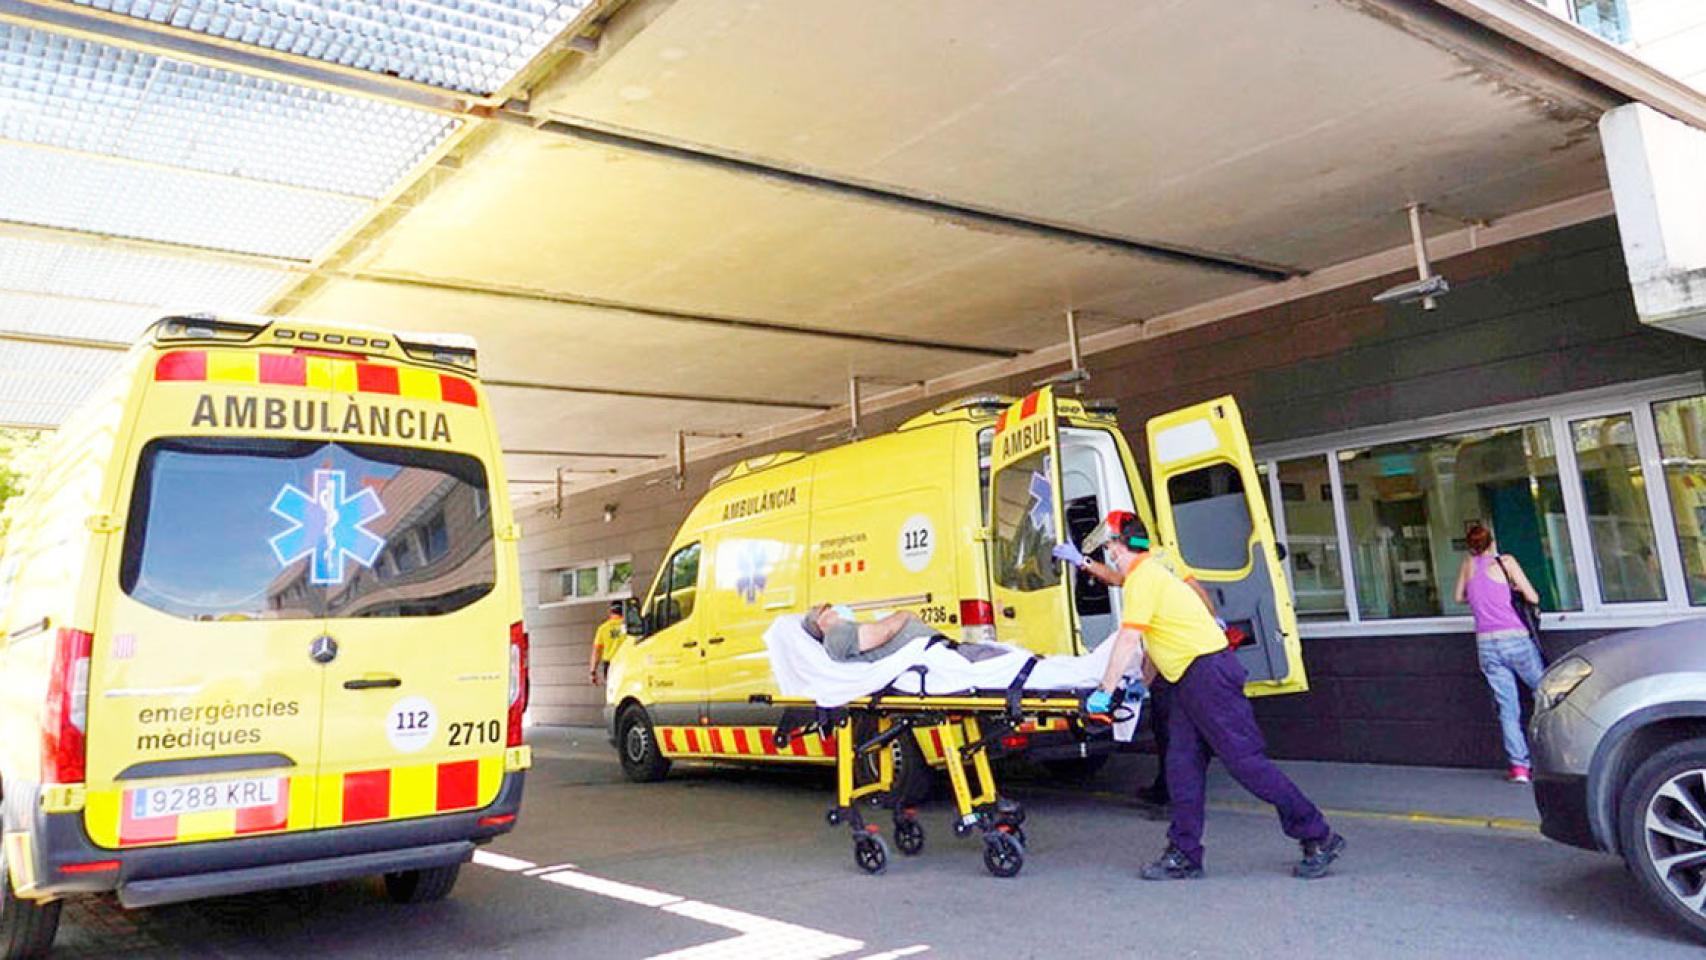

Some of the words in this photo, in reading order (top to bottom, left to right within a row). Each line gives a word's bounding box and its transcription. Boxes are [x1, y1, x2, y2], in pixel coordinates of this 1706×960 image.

[191, 394, 452, 443] AMBULÀNCIA
[1002, 418, 1050, 461] AMBUL
[903, 529, 928, 550] 112
[138, 698, 300, 726] emergències
[396, 710, 430, 730] 112
[137, 727, 262, 751] mèdiques
[448, 719, 501, 746] 2710
[152, 786, 218, 813] 9288
[226, 781, 273, 804] KRL
